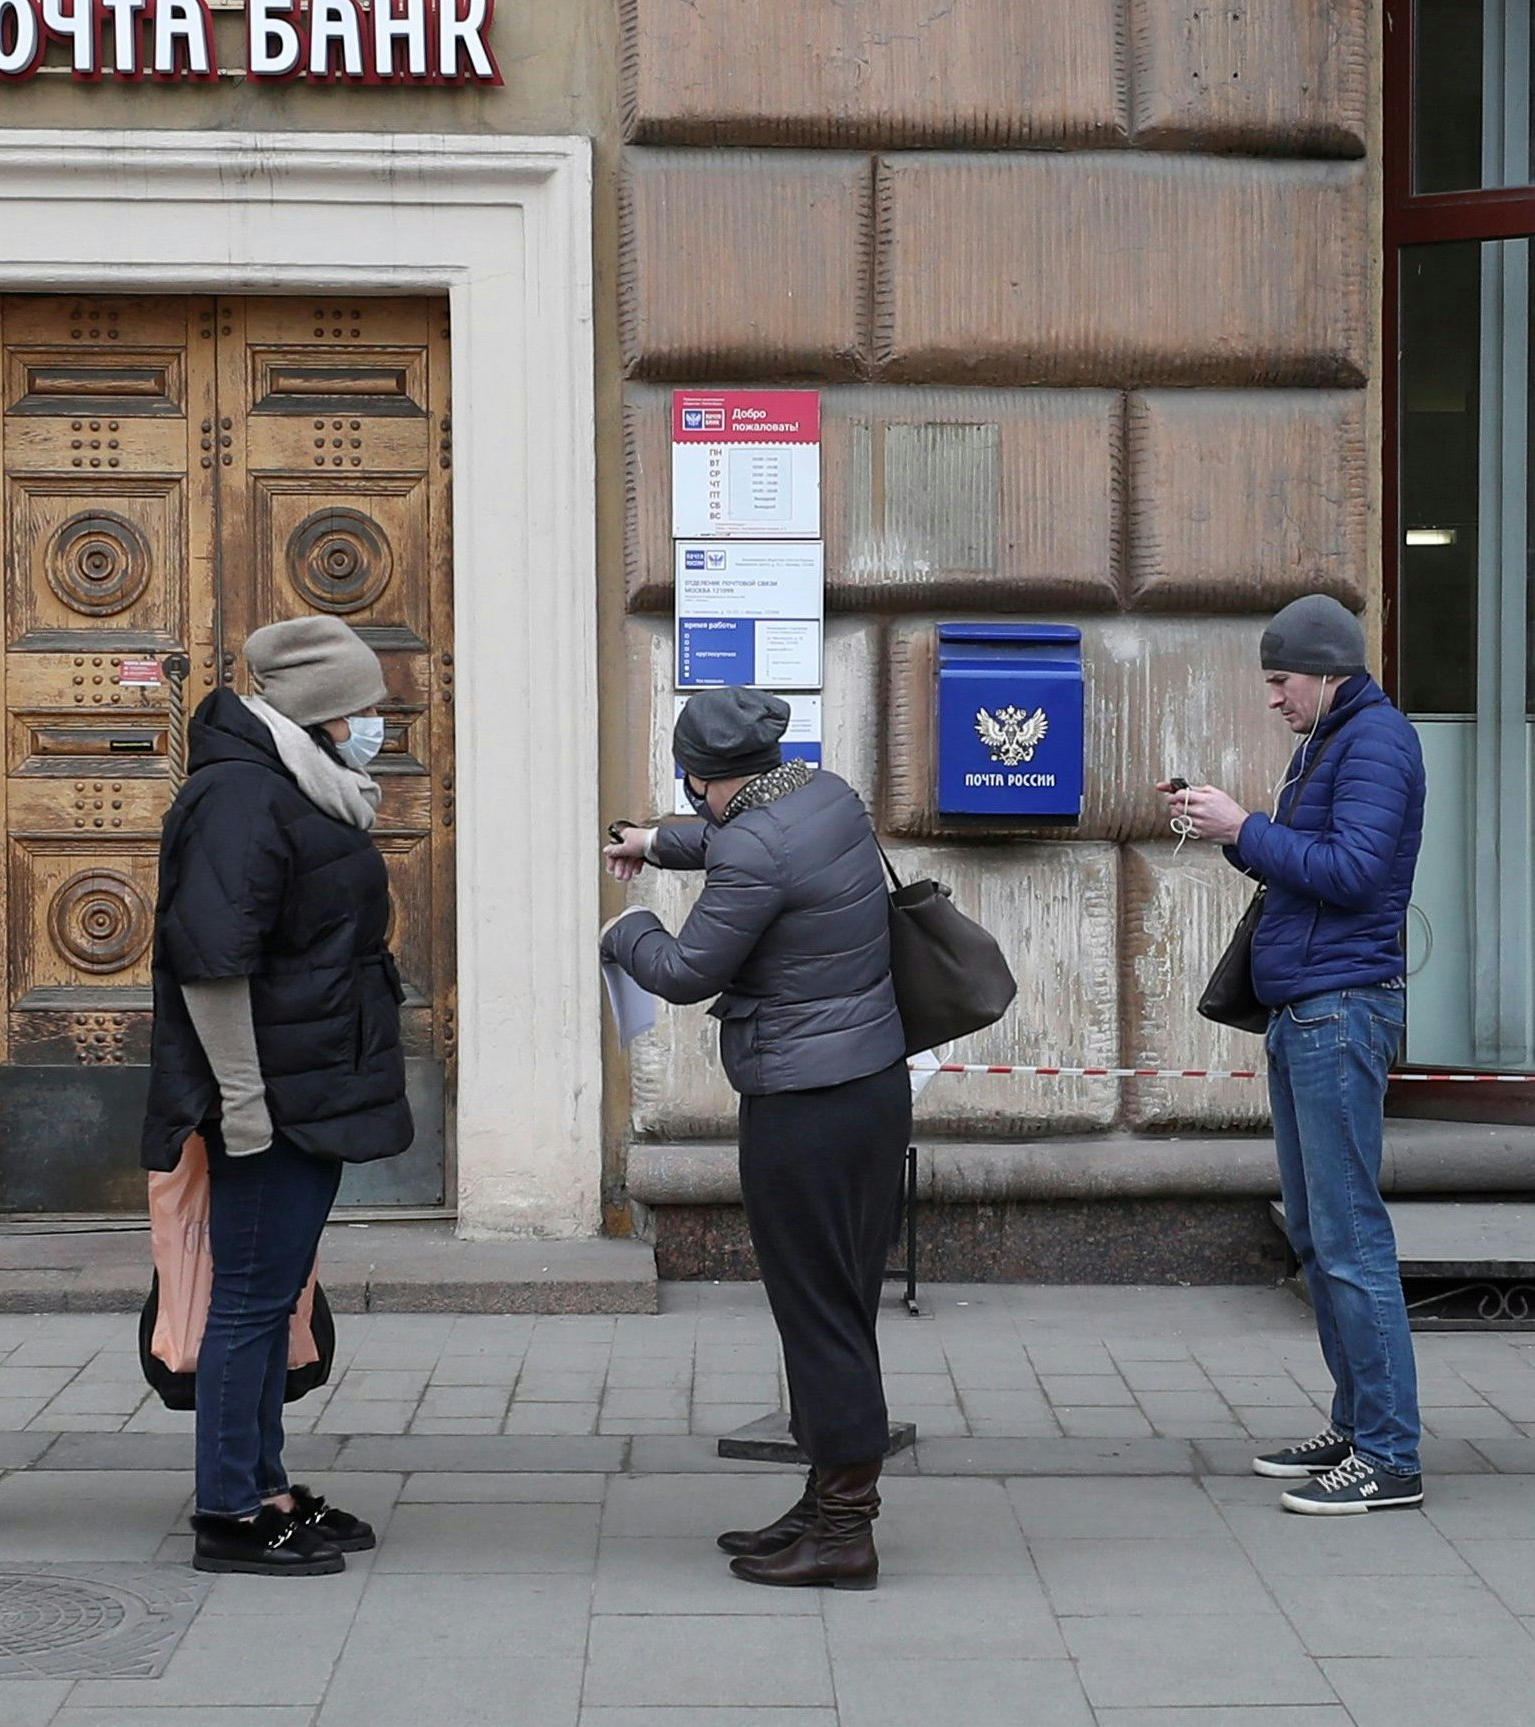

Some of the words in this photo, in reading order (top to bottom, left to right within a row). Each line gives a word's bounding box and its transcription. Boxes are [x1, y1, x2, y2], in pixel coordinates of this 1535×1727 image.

[250, 0, 494, 77] БАНК
[732, 408, 767, 420] Добро
[732, 422, 799, 432] пожаловать!
[708, 621, 737, 629] работы
[965, 773, 1005, 787] ПОЧТА
[1007, 773, 1055, 787] РОССИИ
